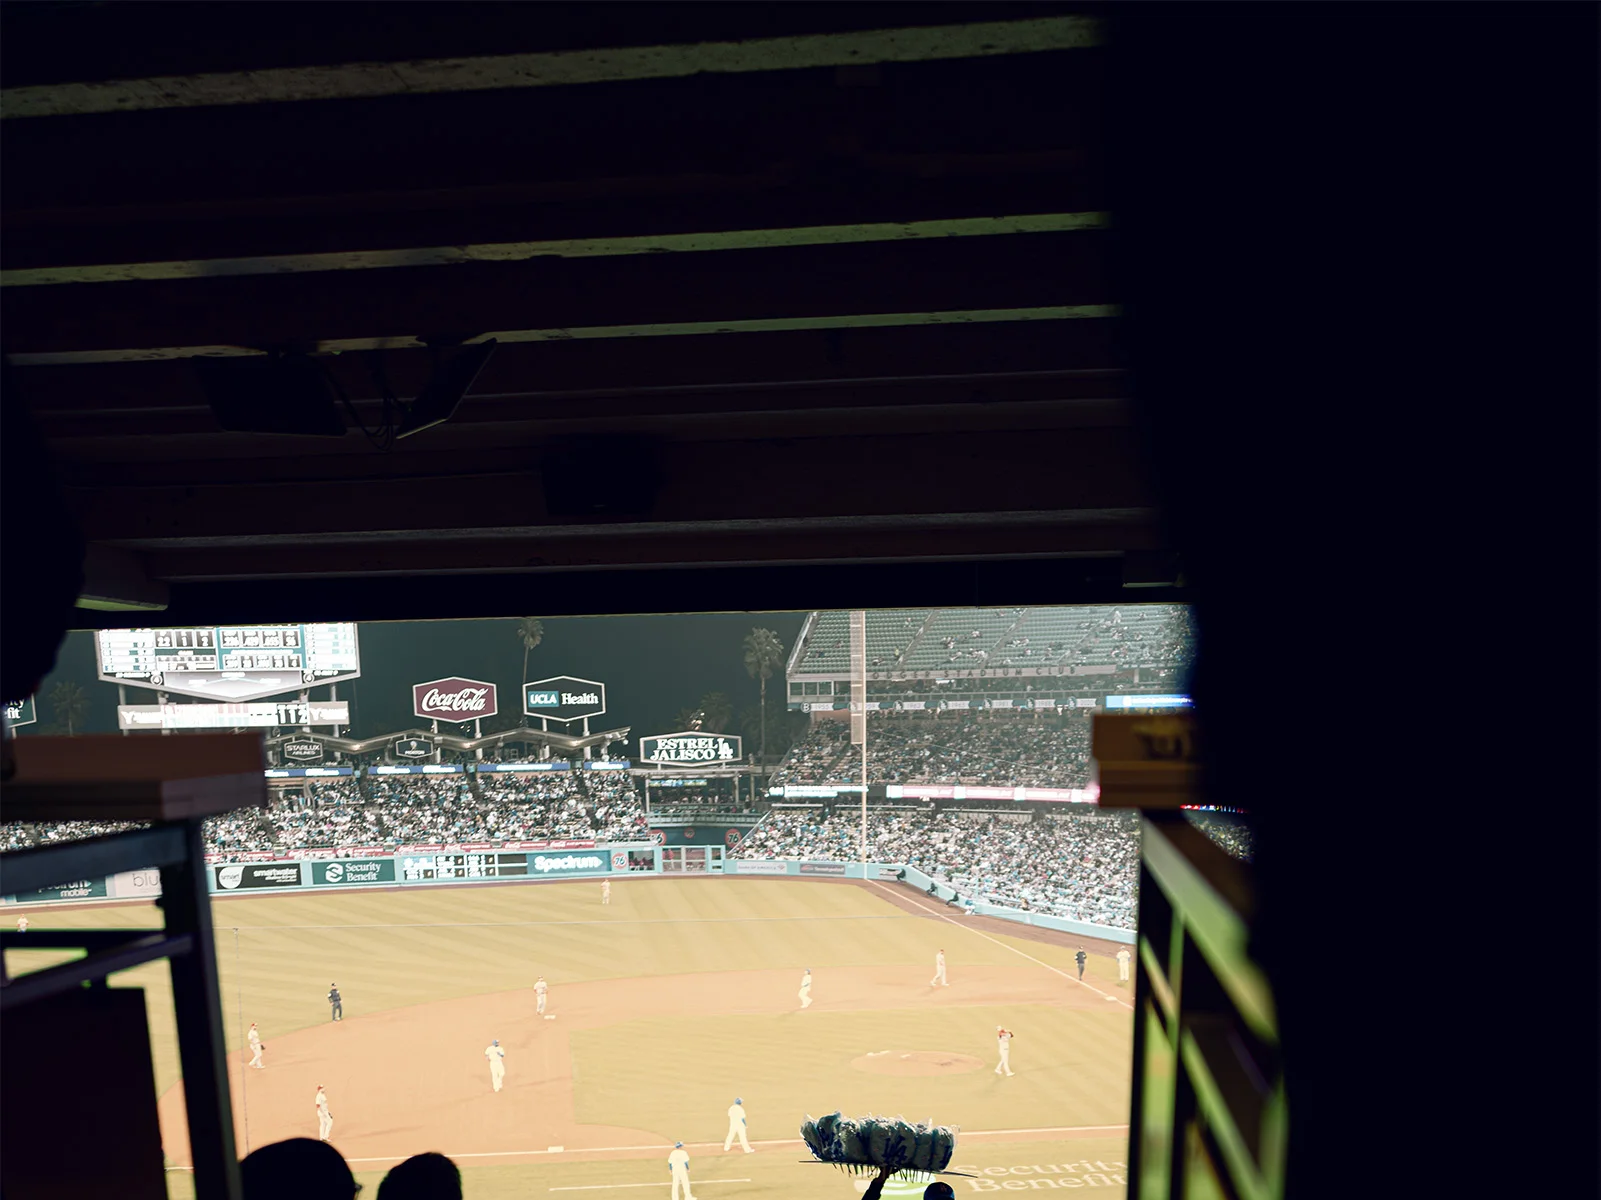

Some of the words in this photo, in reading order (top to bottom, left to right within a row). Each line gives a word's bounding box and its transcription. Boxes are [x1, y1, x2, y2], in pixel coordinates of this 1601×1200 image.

[421, 688, 489, 712] Coca-Cola
[530, 693, 557, 704] UCLA
[561, 692, 599, 705] Health
[650, 748, 716, 761] JALISCO
[728, 833, 739, 843] 76
[345, 862, 381, 873] Security
[534, 855, 599, 872] Spectrum
[615, 857, 625, 866] 76
[346, 872, 378, 882] Benefit
